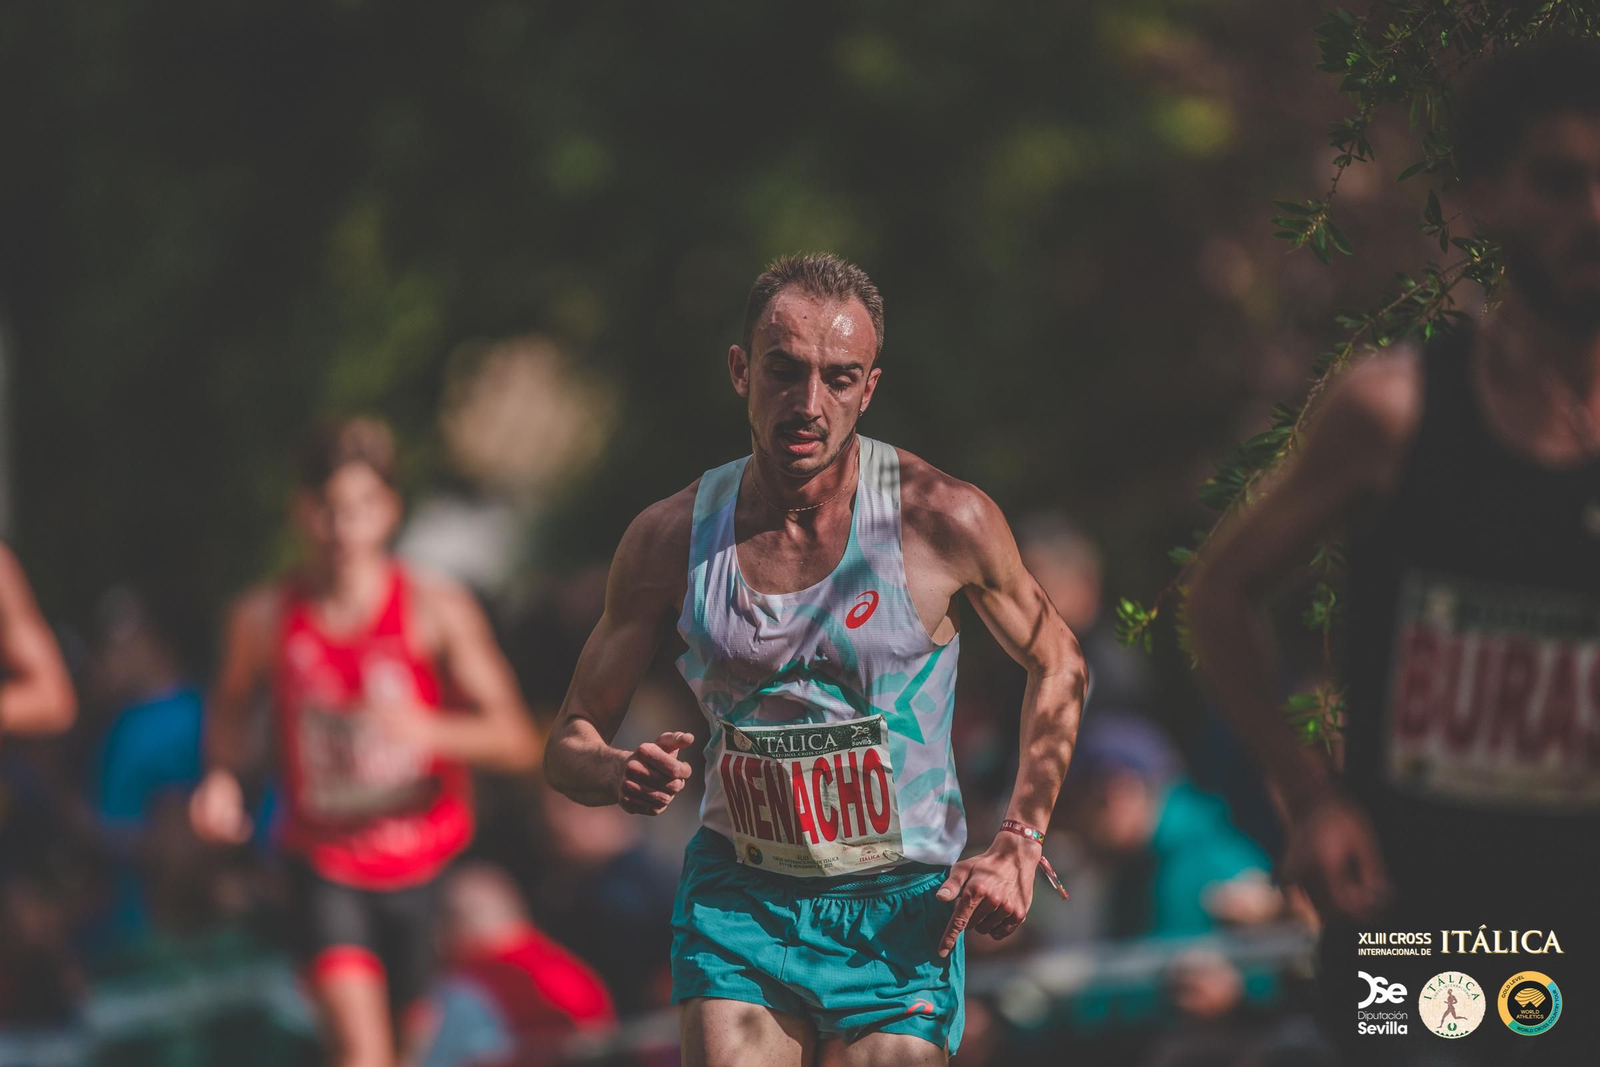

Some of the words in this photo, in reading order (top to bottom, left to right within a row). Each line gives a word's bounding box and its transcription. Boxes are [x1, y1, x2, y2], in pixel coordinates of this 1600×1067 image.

[755, 732, 838, 753] ITÁLICA
[1393, 624, 1600, 768] BURA
[720, 748, 891, 846] MENACHO
